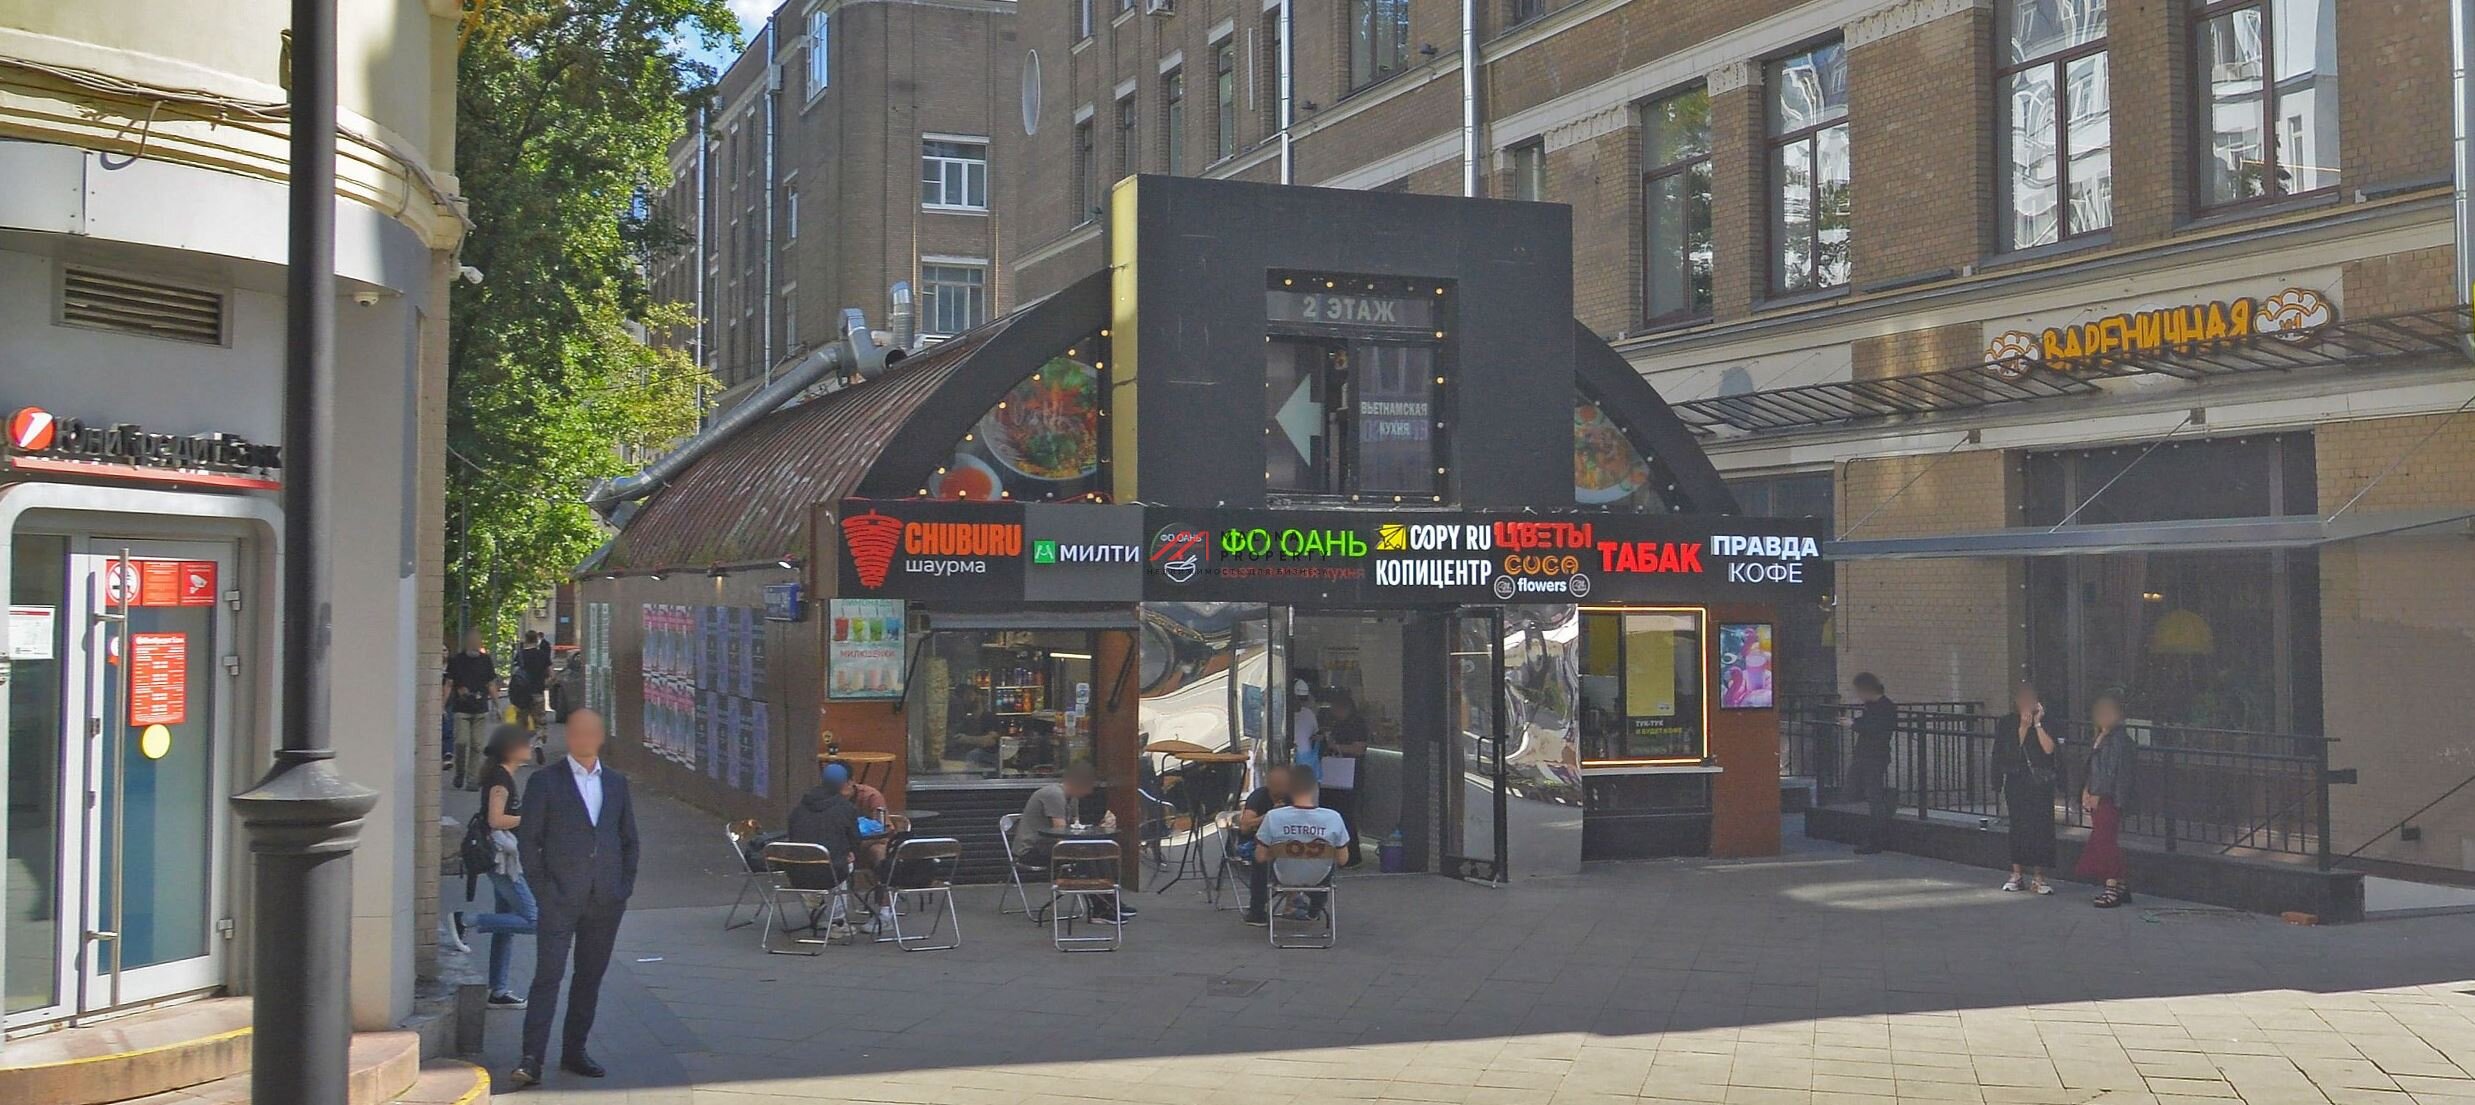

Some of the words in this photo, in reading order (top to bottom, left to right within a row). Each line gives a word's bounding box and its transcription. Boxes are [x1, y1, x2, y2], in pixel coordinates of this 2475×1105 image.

[1303, 296, 1317, 317] 2
[1327, 298, 1396, 322] ЭТАЖ
[2042, 298, 2251, 362] ВАРЕНИЧНАЯ
[1361, 401, 1428, 416] ВЬЕТНАМСКАЯ
[1379, 422, 1411, 436] КУХНЯ
[904, 521, 1022, 556] CHUBURU
[1221, 528, 1271, 556] ФО
[1280, 528, 1368, 557] ОАНЬ
[1410, 524, 1460, 550] COPY
[1466, 524, 1491, 550] RU
[1494, 521, 1593, 552] ЦВЕТЫ
[1710, 535, 1819, 560] ПРАВДА
[1059, 544, 1140, 562] МИЛТИ
[1597, 541, 1703, 573] ТАБАК
[905, 558, 986, 576] шаурма
[1376, 559, 1492, 588] КОПИЦЕНТР
[1727, 562, 1804, 583] КОФЕ
[1516, 577, 1567, 592] flowers
[1283, 825, 1327, 836] DETROIT
